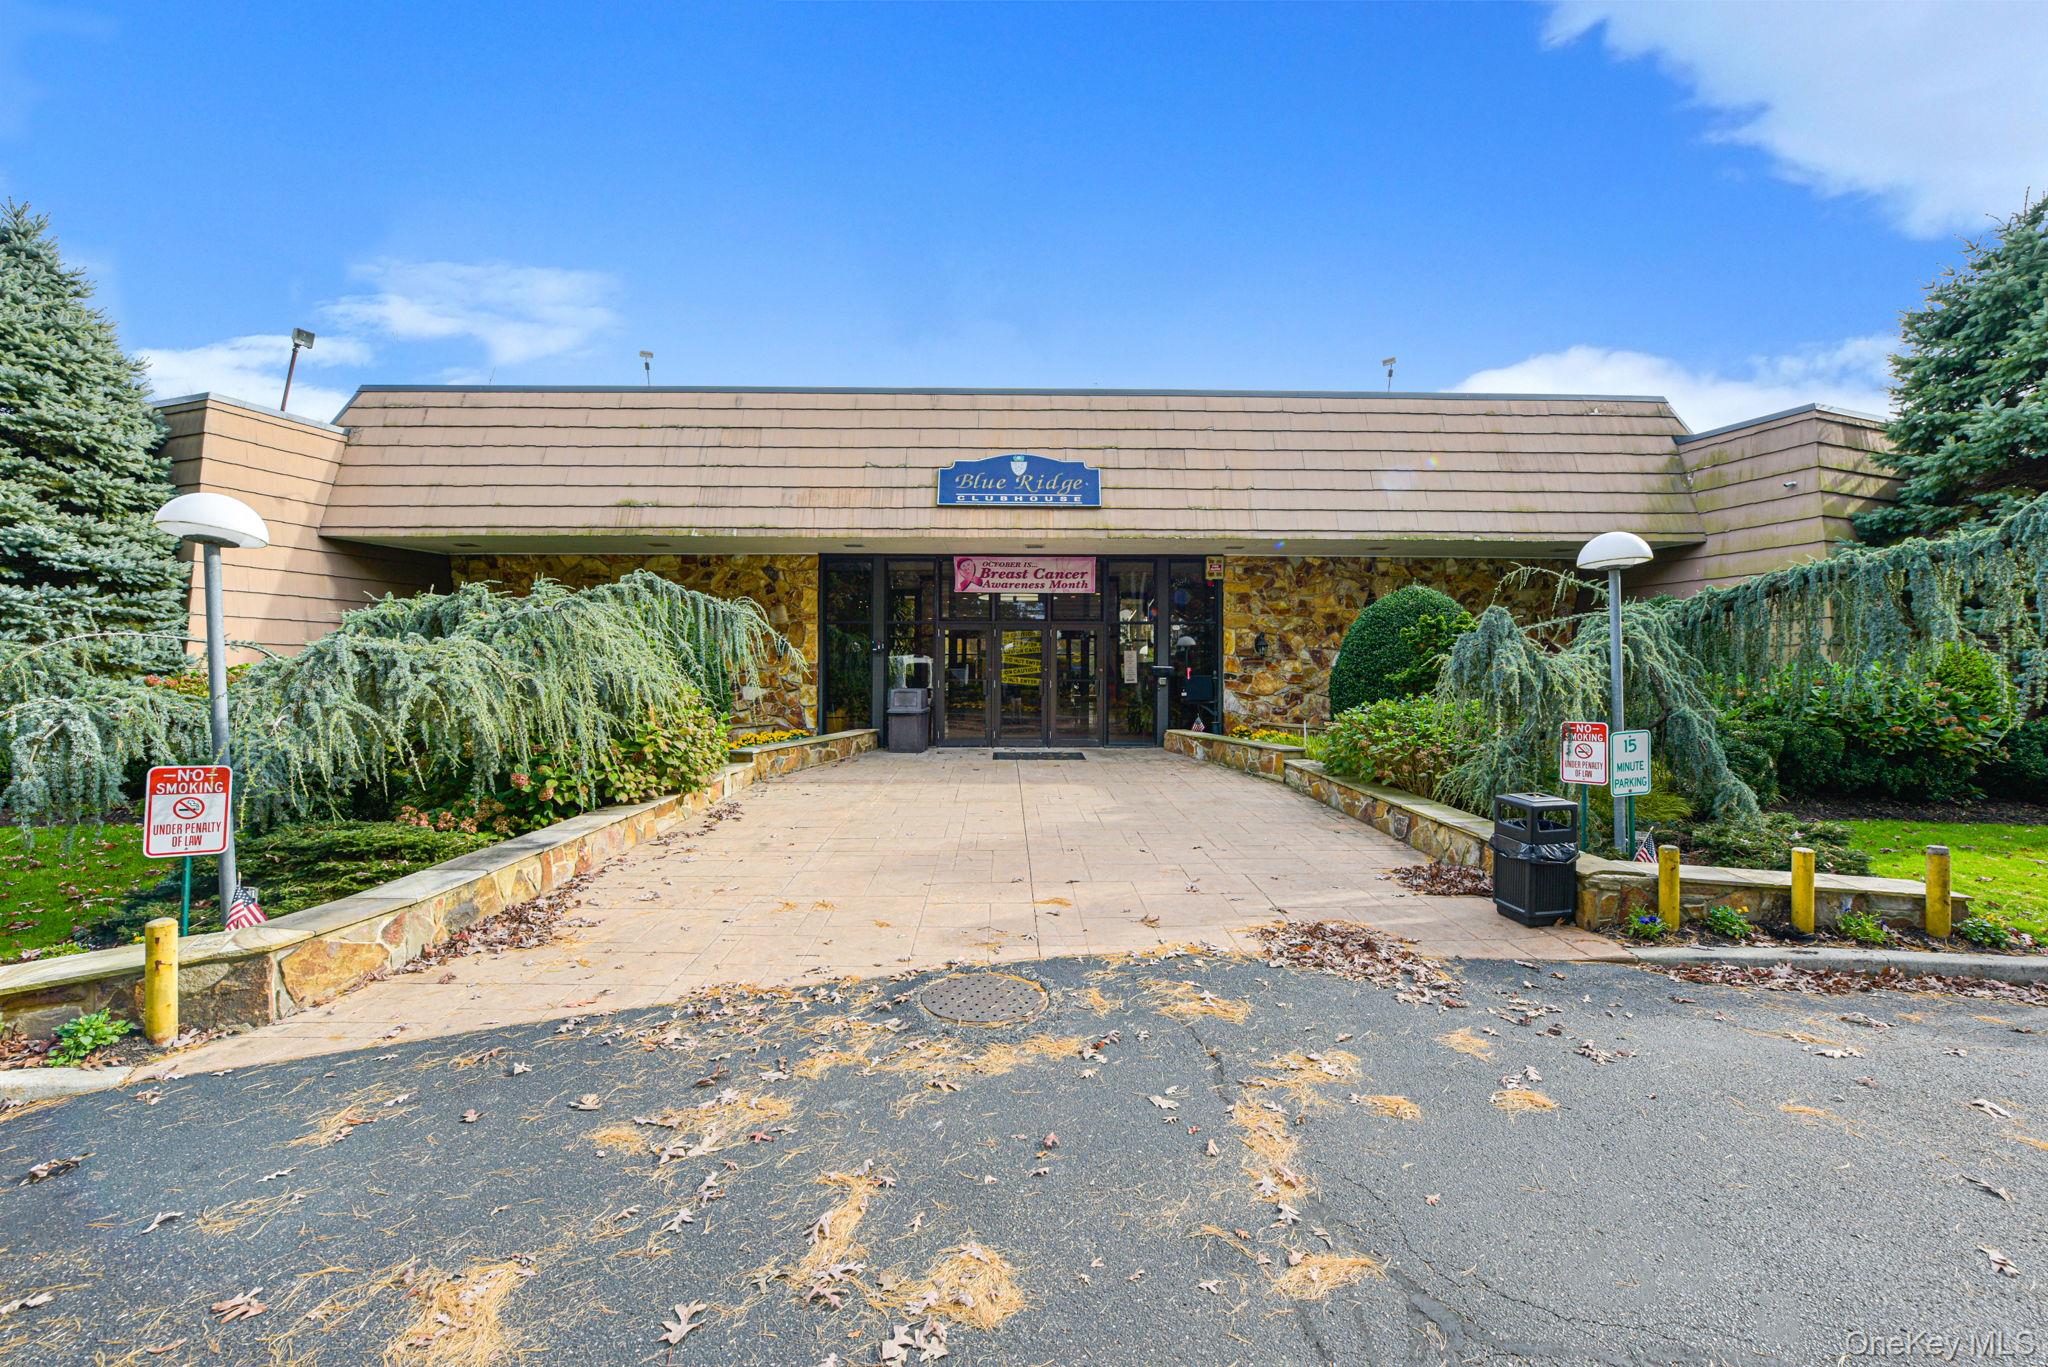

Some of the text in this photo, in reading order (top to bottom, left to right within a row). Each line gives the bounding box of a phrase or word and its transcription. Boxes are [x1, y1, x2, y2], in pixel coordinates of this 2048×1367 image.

[955, 472, 1083, 494] Blue Ridge
[980, 567, 1088, 579] Breast Cancer
[982, 580, 1088, 589] Awareness Month
[1576, 724, 1592, 733] NO
[1565, 733, 1603, 741] SMOKING
[1624, 738, 1637, 753] 15
[1565, 760, 1581, 768] UNDER
[1617, 761, 1644, 772] MINUTE
[177, 769, 204, 782] NO
[1582, 770, 1593, 778] LAW
[156, 782, 223, 794] SMOKING
[1615, 777, 1647, 788] PARKING
[153, 821, 221, 836] UNDER PENALTY
[172, 835, 203, 847] OF LAW
